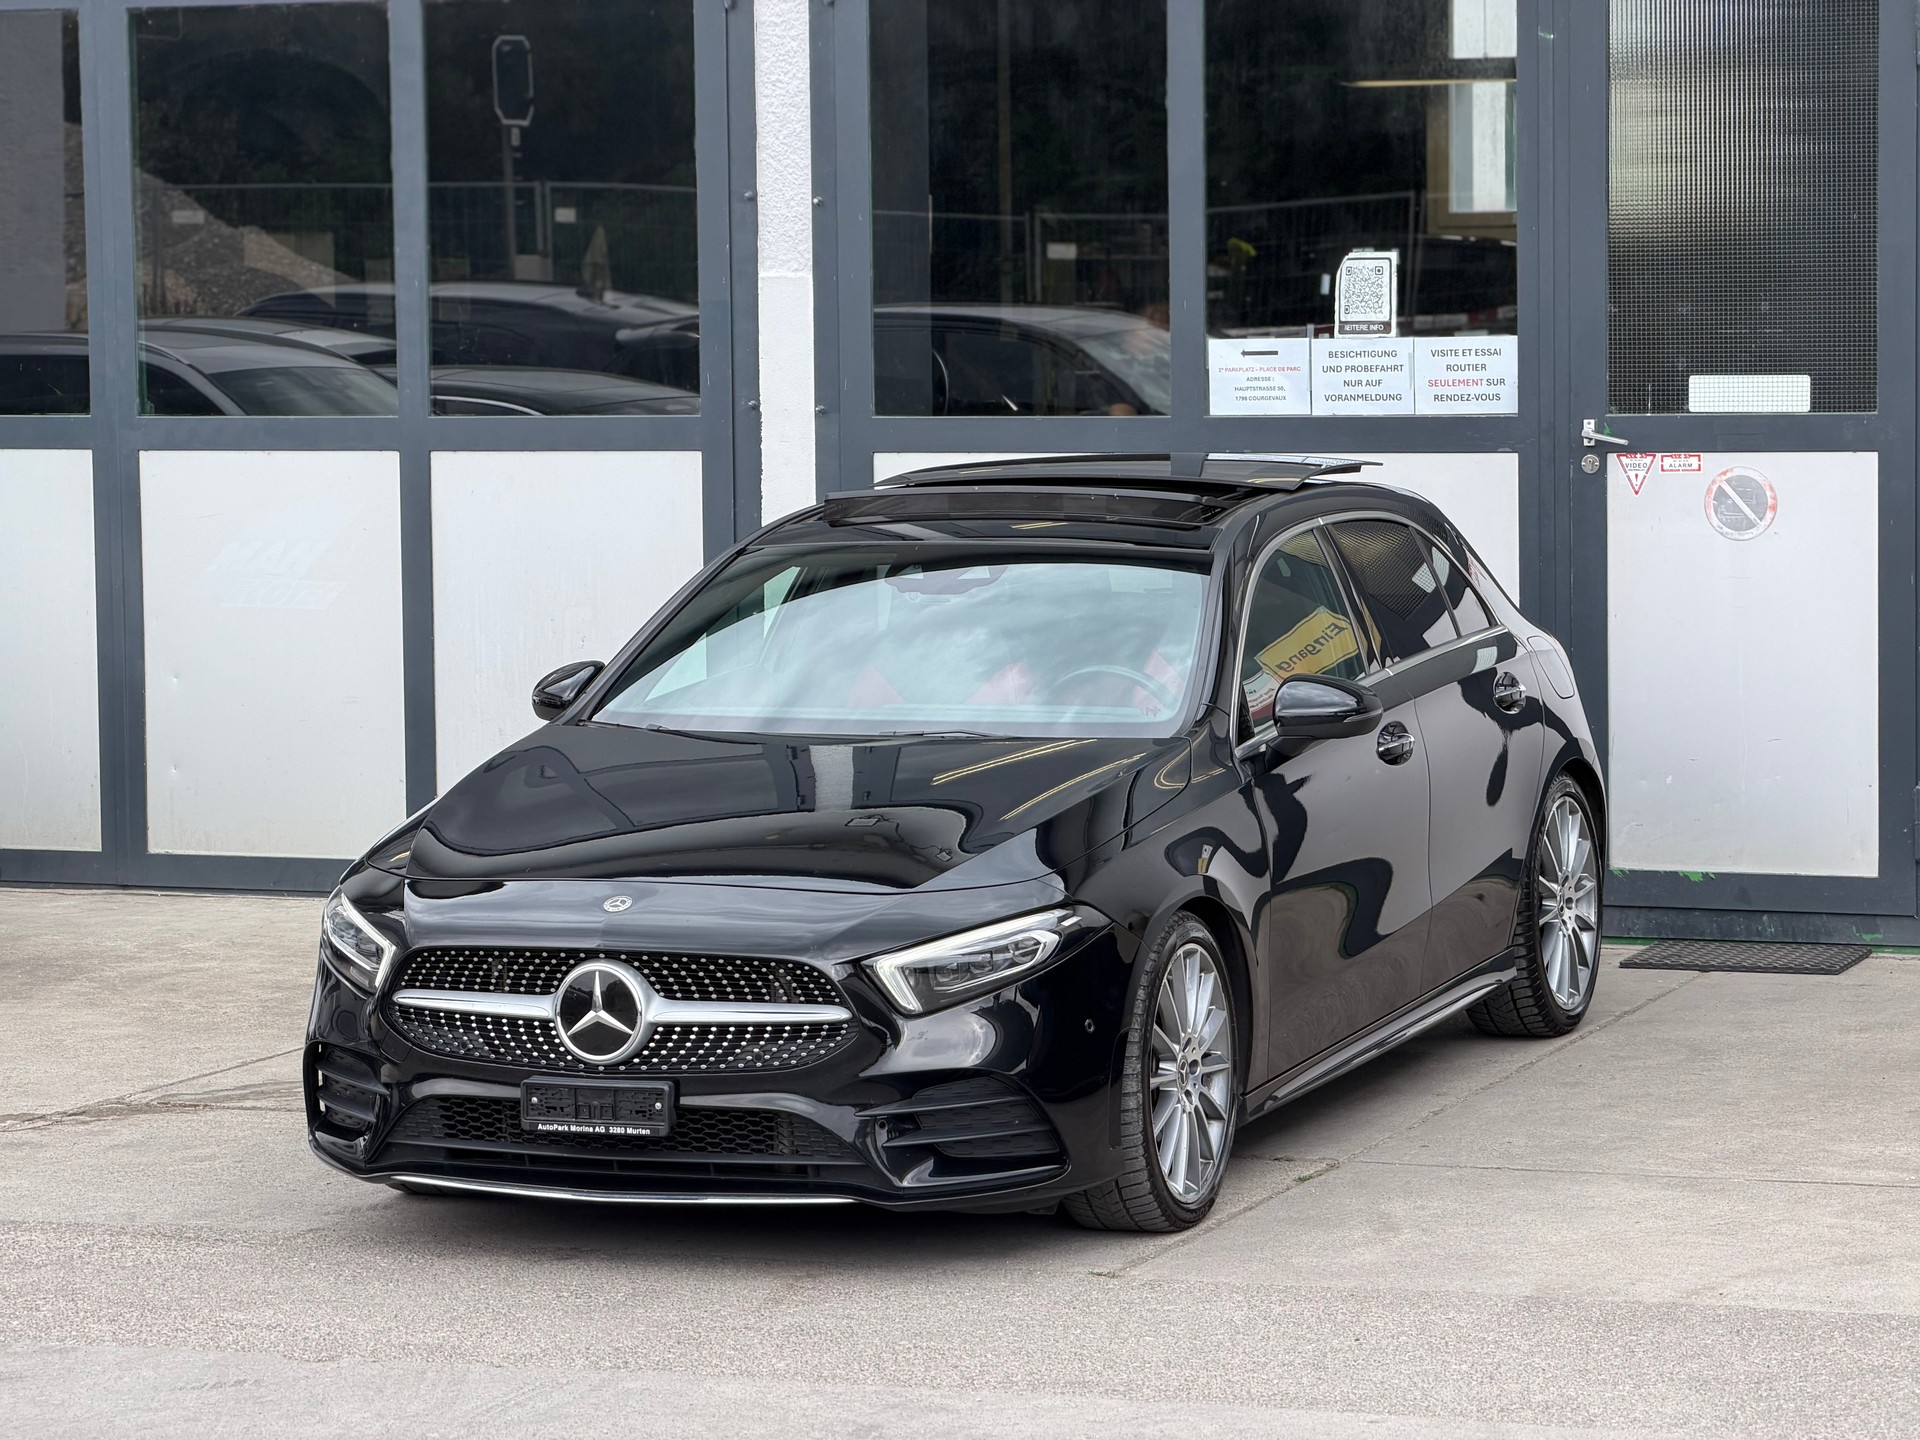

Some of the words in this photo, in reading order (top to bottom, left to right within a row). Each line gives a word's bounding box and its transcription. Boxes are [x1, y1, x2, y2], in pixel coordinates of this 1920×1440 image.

[1328, 350, 1398, 358] BESICHTIGUNG
[1430, 348, 1460, 357] VISITE
[1461, 348, 1473, 357] ET
[1474, 348, 1502, 357] ESSAI
[1322, 365, 1342, 373] UND
[1344, 364, 1404, 373] PROBEFAHRT
[1446, 363, 1487, 372] ROUTIER
[1343, 379, 1363, 387] NUR
[1365, 379, 1383, 387] AUF
[1428, 378, 1484, 387] SEULEMENT
[1486, 378, 1506, 387] SUR
[1324, 393, 1403, 402] VORANMELDUNG
[1433, 393, 1501, 402] RENDEZ-VOUS
[537, 1123, 568, 1132] AutoPark
[594, 1125, 606, 1133] AG
[627, 1127, 650, 1135] Murten
